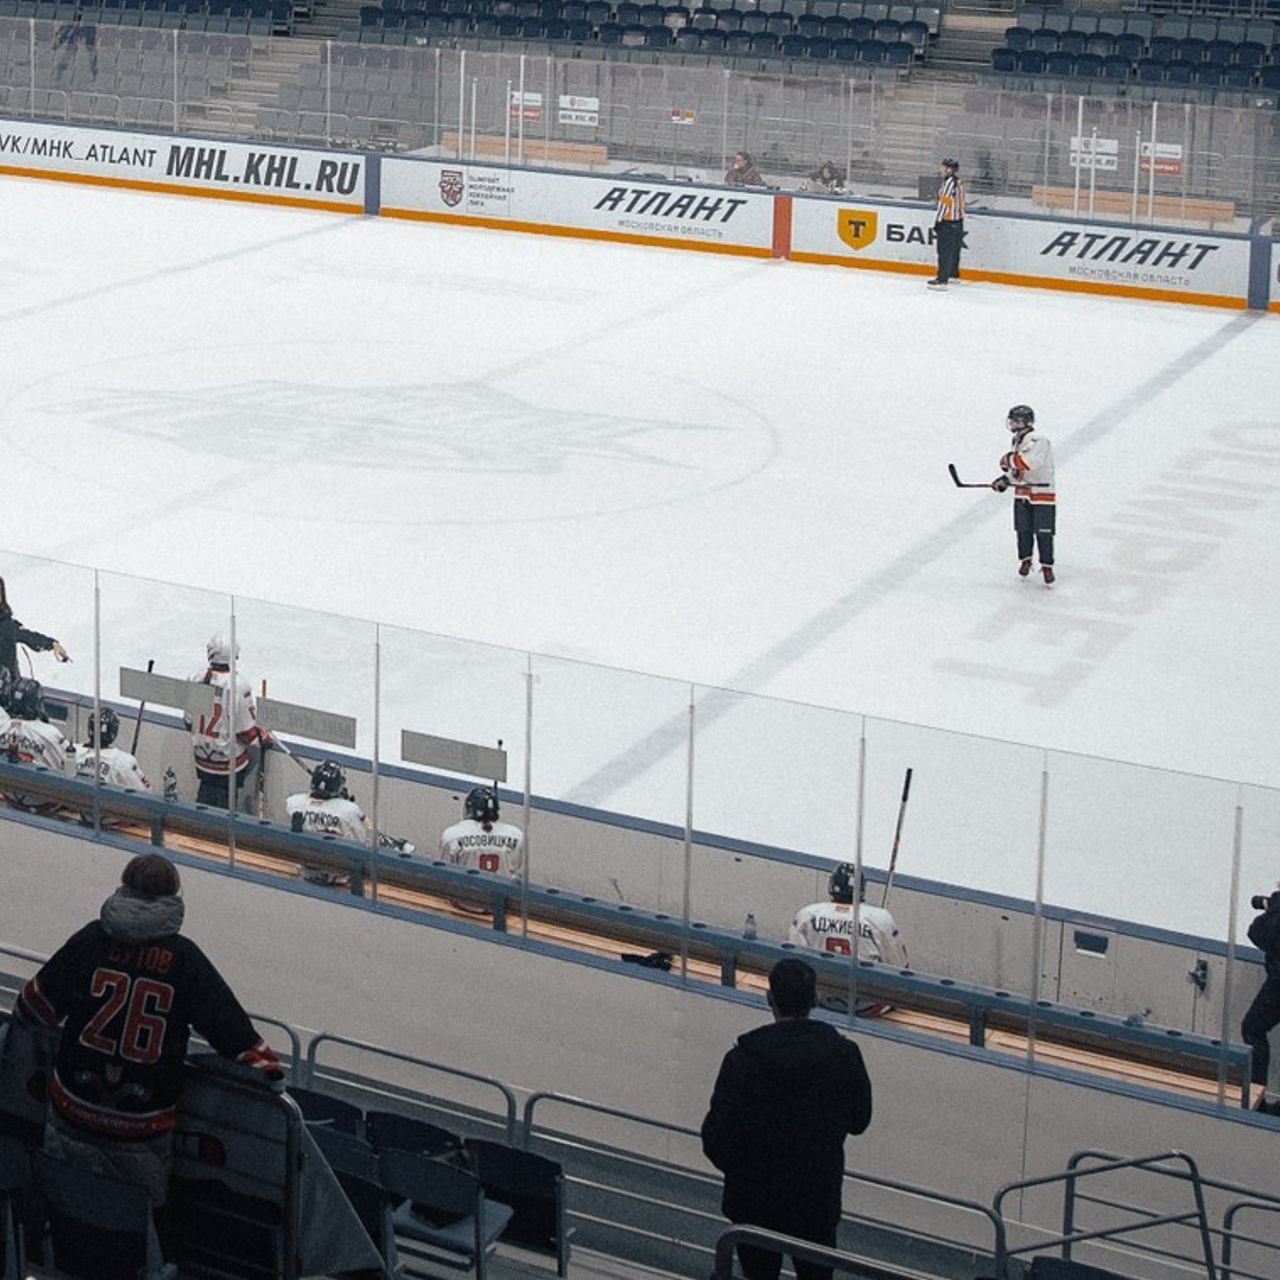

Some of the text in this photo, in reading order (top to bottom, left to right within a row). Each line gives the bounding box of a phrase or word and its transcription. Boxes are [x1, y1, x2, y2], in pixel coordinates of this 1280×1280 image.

[165, 144, 361, 195] MHL.KHL.RU
[594, 187, 748, 224] АТЛАНТ
[1040, 231, 1219, 271] АТЛАНТ
[79, 967, 175, 1064] 26
